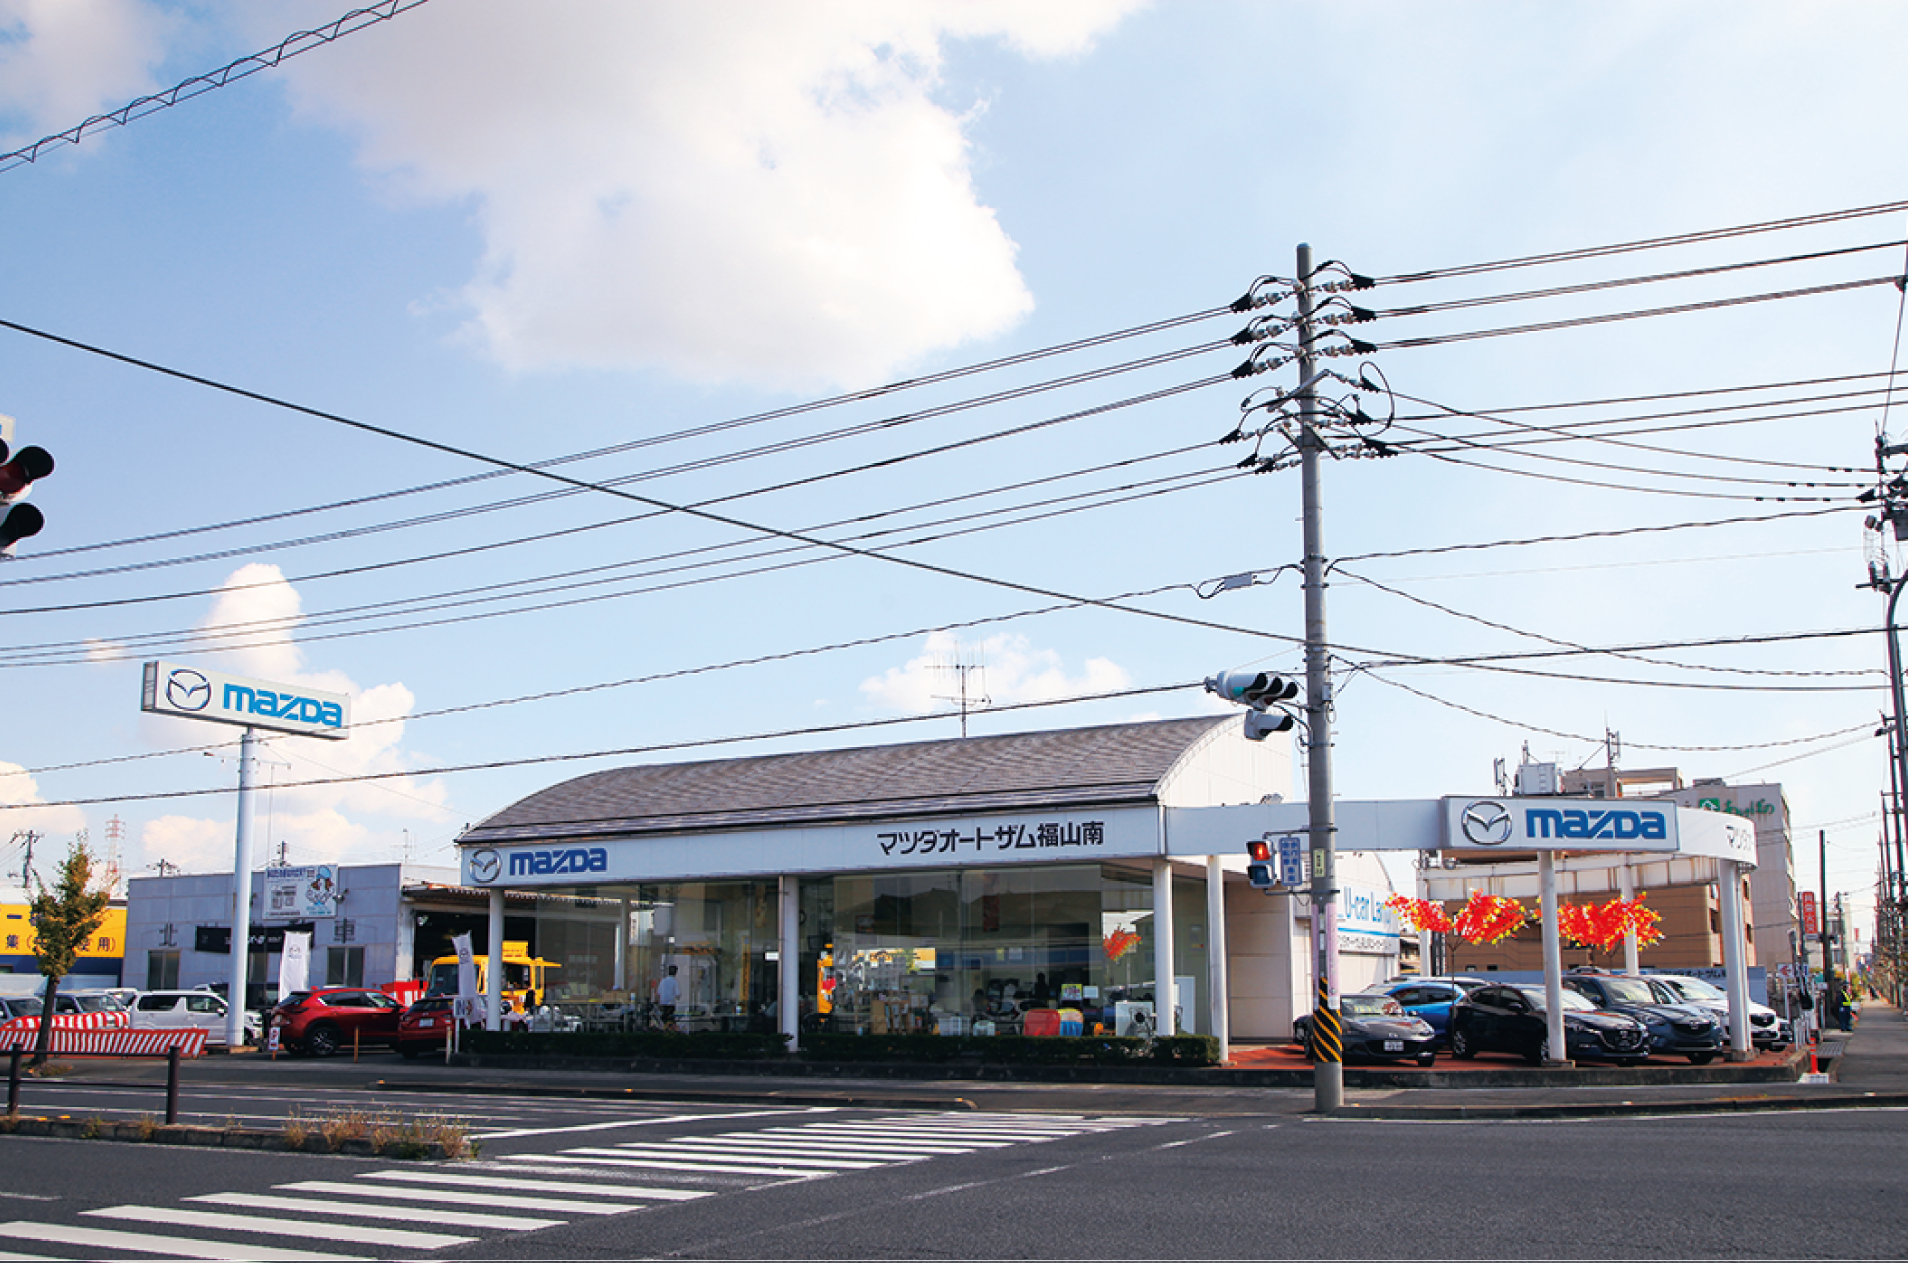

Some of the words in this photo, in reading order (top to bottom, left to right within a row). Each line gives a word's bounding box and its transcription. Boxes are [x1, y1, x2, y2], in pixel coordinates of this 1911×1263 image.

[877, 820, 1104, 856] マツダオートザム福山南
